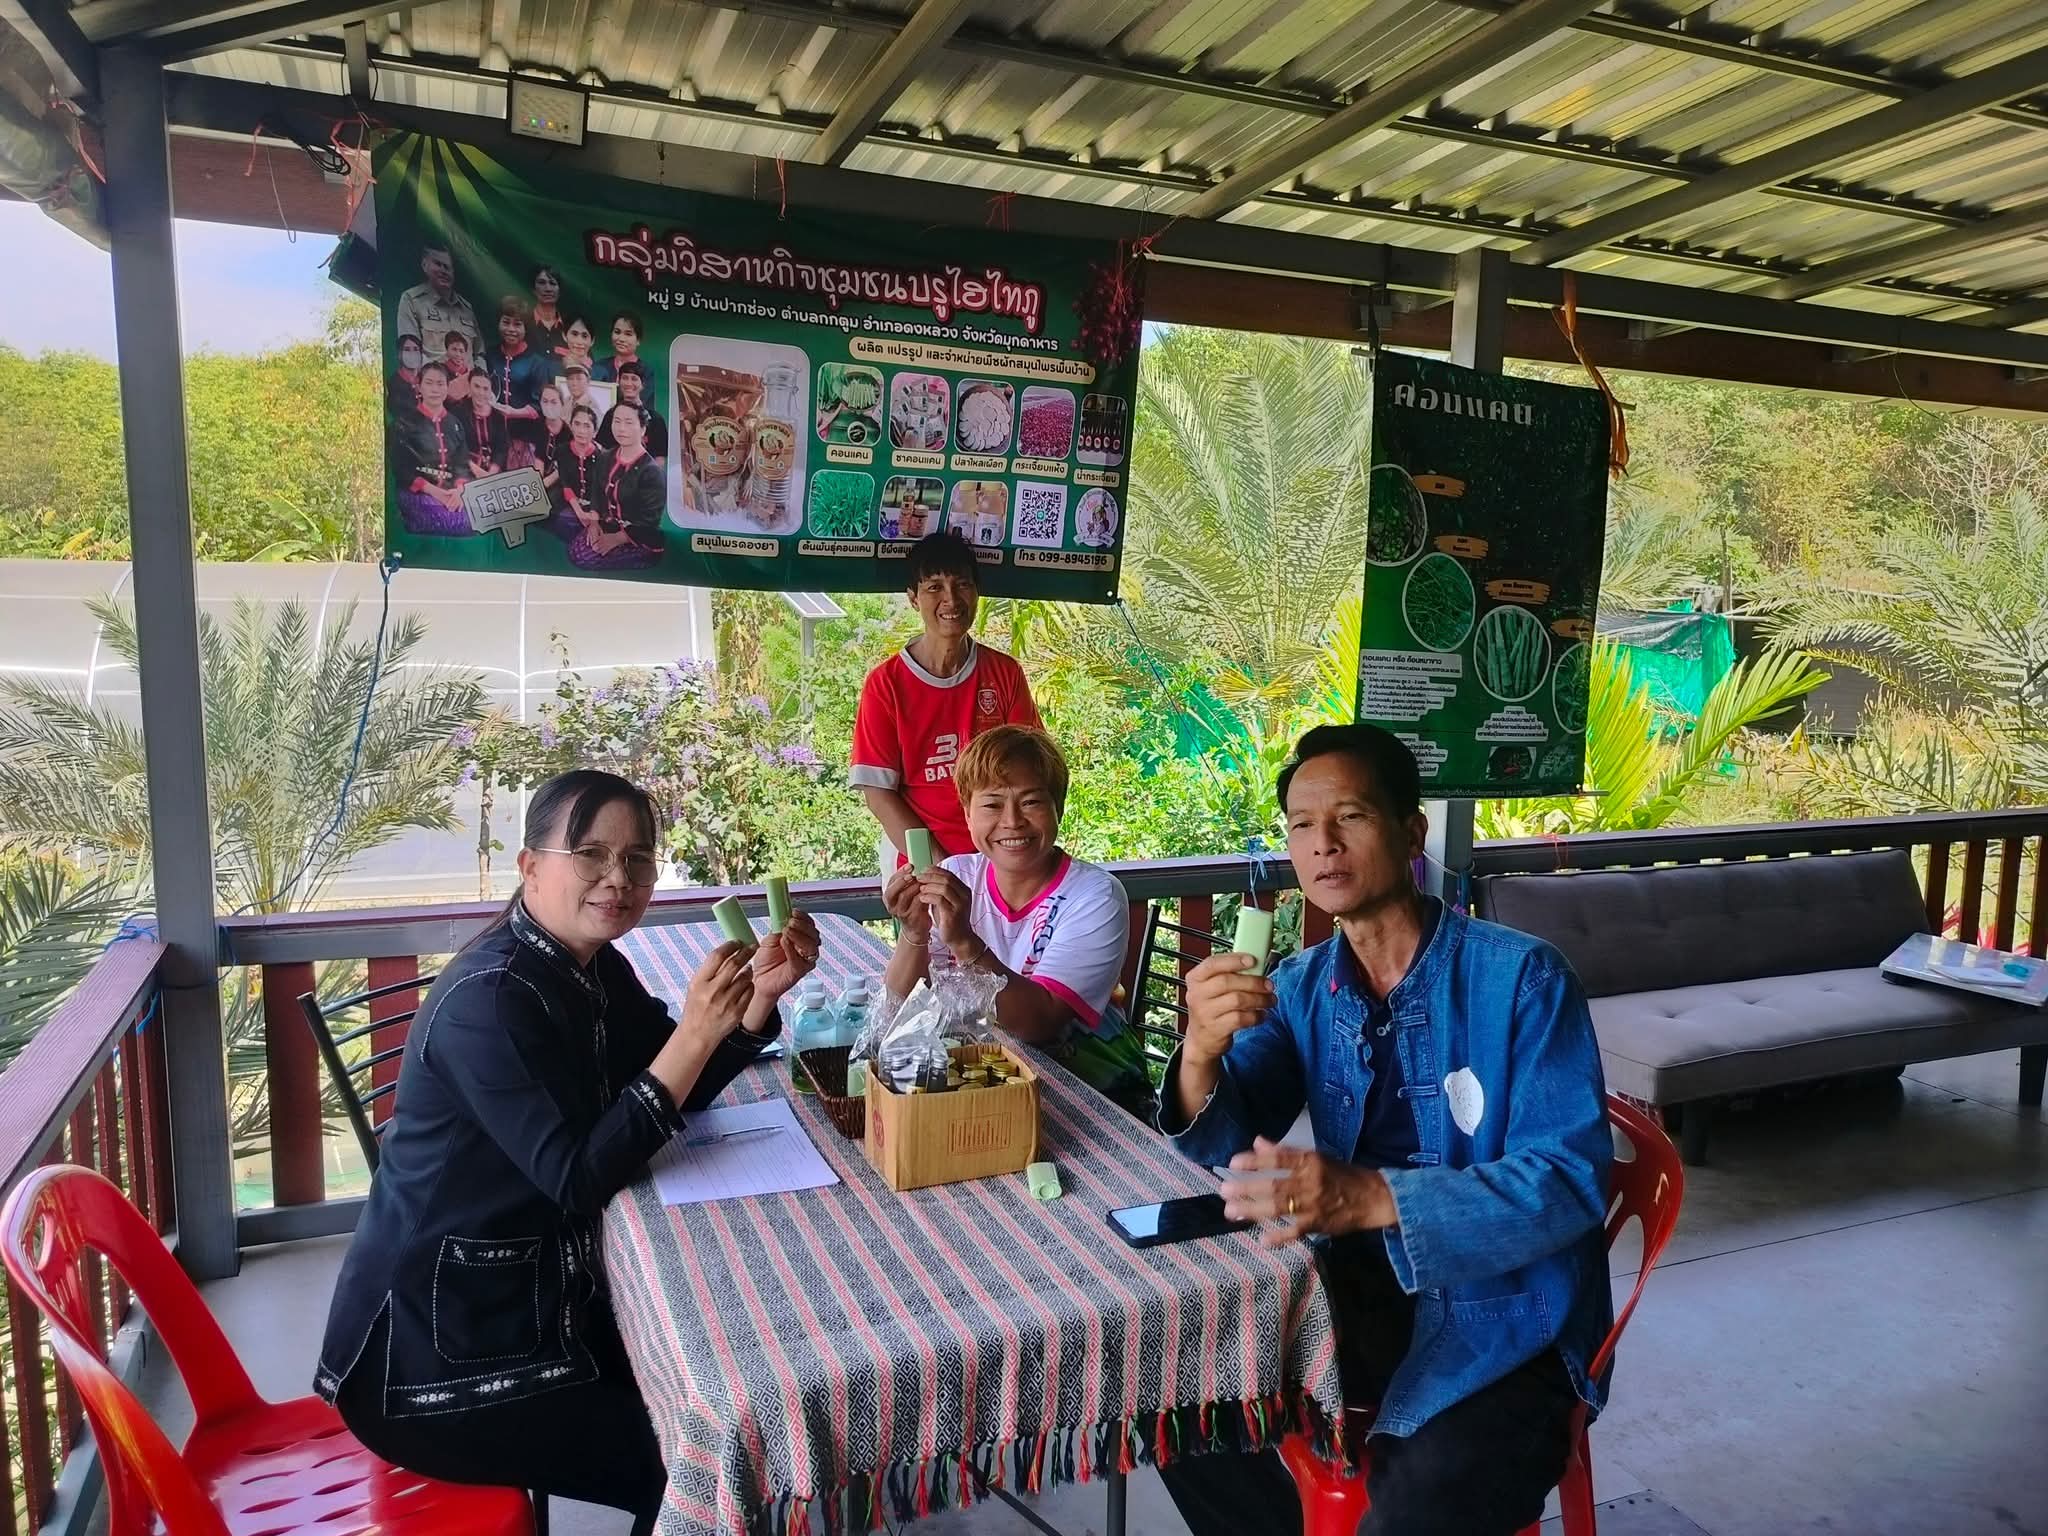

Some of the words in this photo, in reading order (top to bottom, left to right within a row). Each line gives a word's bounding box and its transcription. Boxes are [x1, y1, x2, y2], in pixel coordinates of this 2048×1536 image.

[648, 288, 669, 310] หมู่
[674, 292, 685, 306] 9
[690, 294, 777, 318] บ้านปากช่อง
[863, 315, 958, 340] อำเภอดงหลวง
[962, 325, 1058, 352] จังหวัดมุกดาหาร
[857, 341, 884, 354] ผลิต
[887, 344, 923, 361] แปรรูป
[830, 449, 869, 460] คอนแคน
[475, 481, 543, 519] HERBS
[924, 763, 956, 783] BAT
